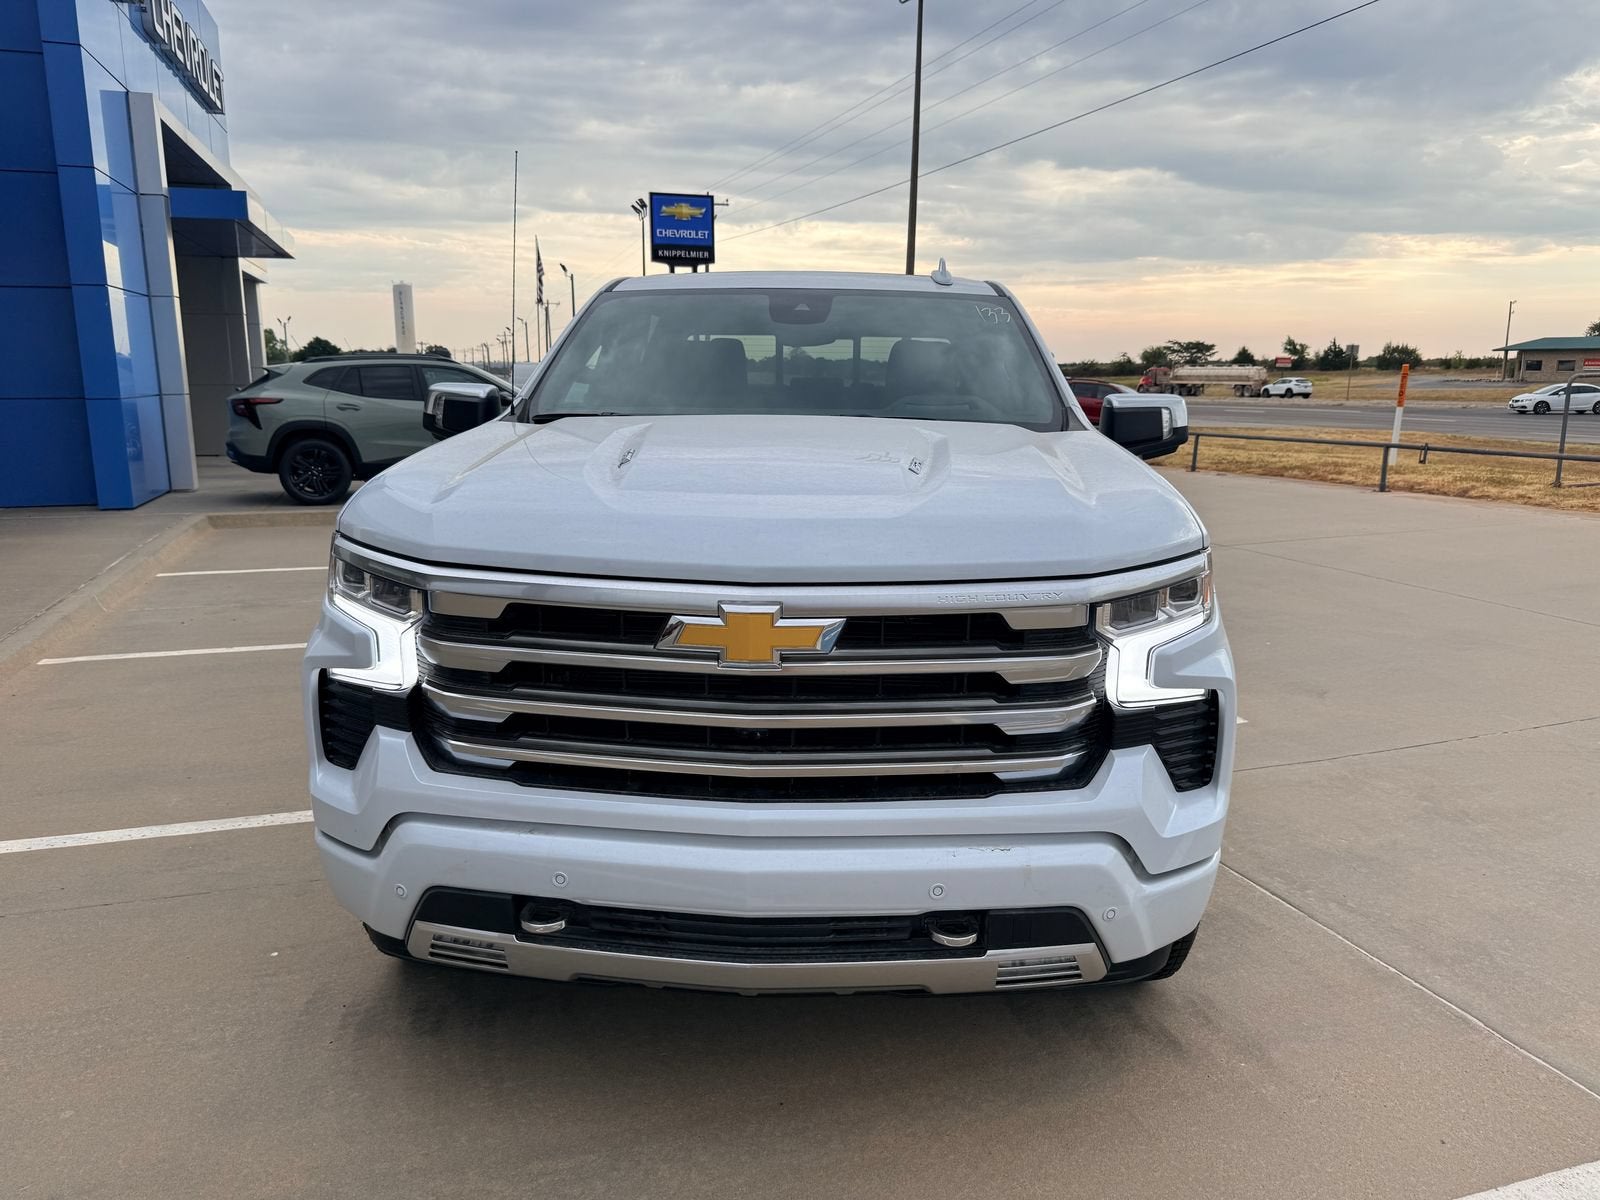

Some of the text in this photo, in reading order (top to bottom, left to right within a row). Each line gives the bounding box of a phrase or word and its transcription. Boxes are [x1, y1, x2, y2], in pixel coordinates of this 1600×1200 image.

[656, 228, 709, 239] CHEVROLET
[658, 249, 709, 258] KNIPPELMIER
[937, 591, 1063, 604] HIGH COUNTRY
